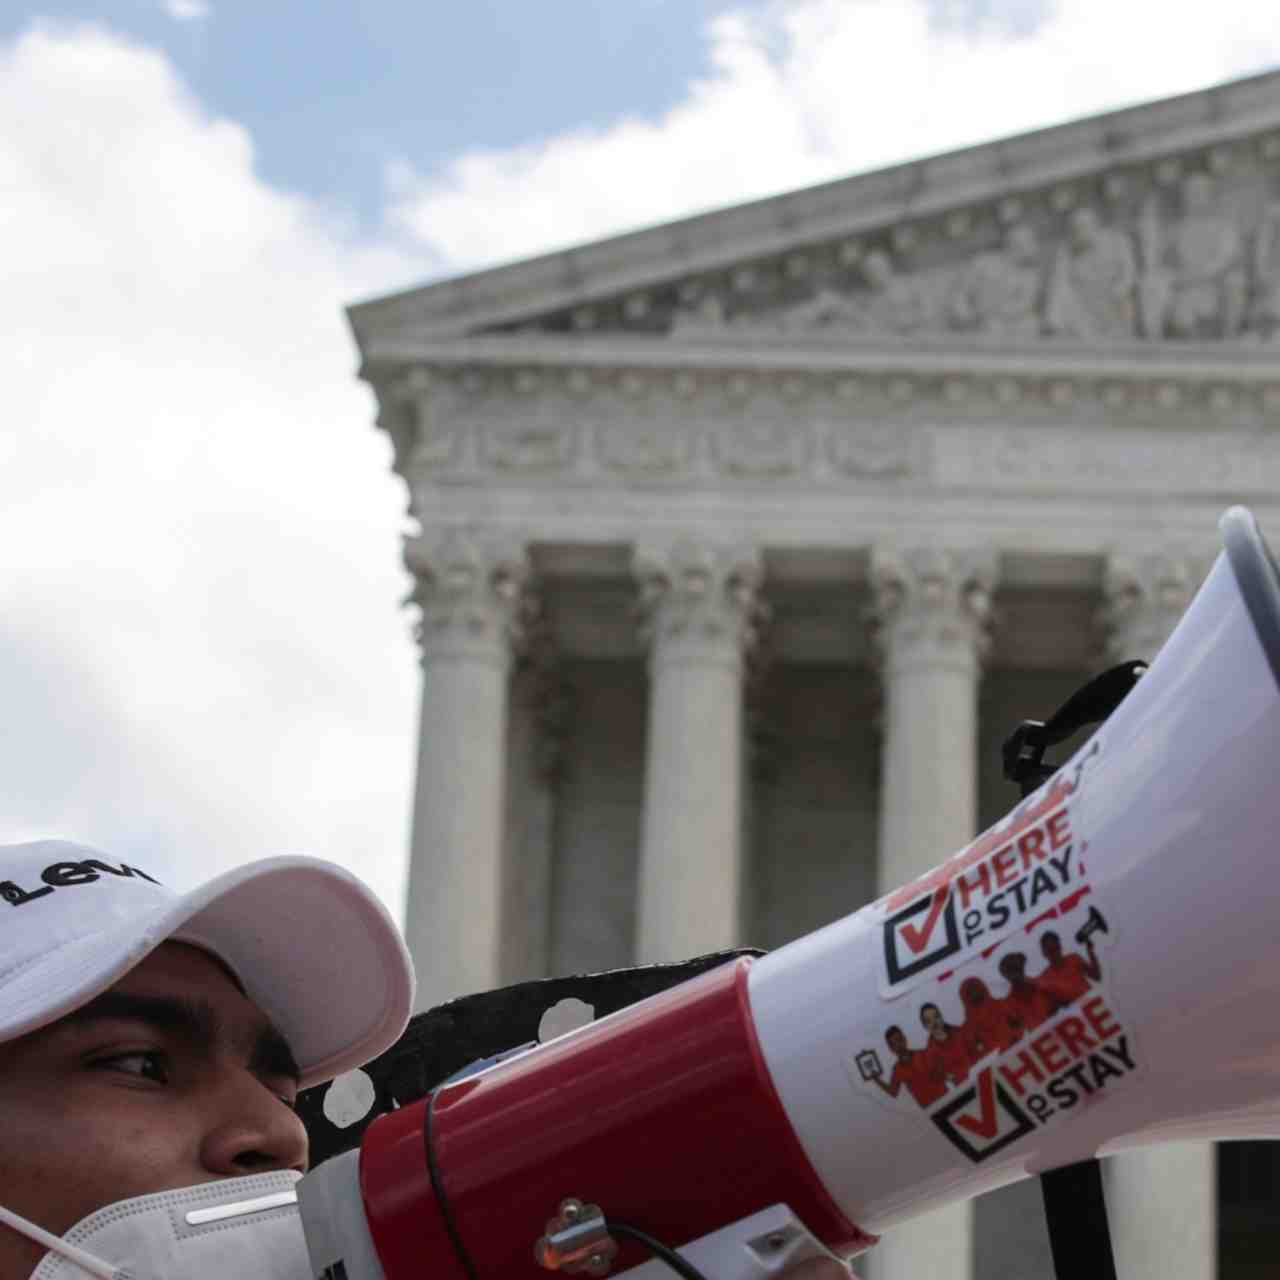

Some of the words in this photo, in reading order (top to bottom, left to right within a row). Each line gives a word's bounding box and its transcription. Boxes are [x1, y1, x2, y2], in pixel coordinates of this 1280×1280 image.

[956, 808, 1073, 910] HERE
[963, 909, 984, 946] TO
[986, 845, 1072, 931] STAY
[999, 996, 1121, 1096] HERE
[1026, 1093, 1055, 1124] TO
[1047, 1034, 1136, 1110] STAY
